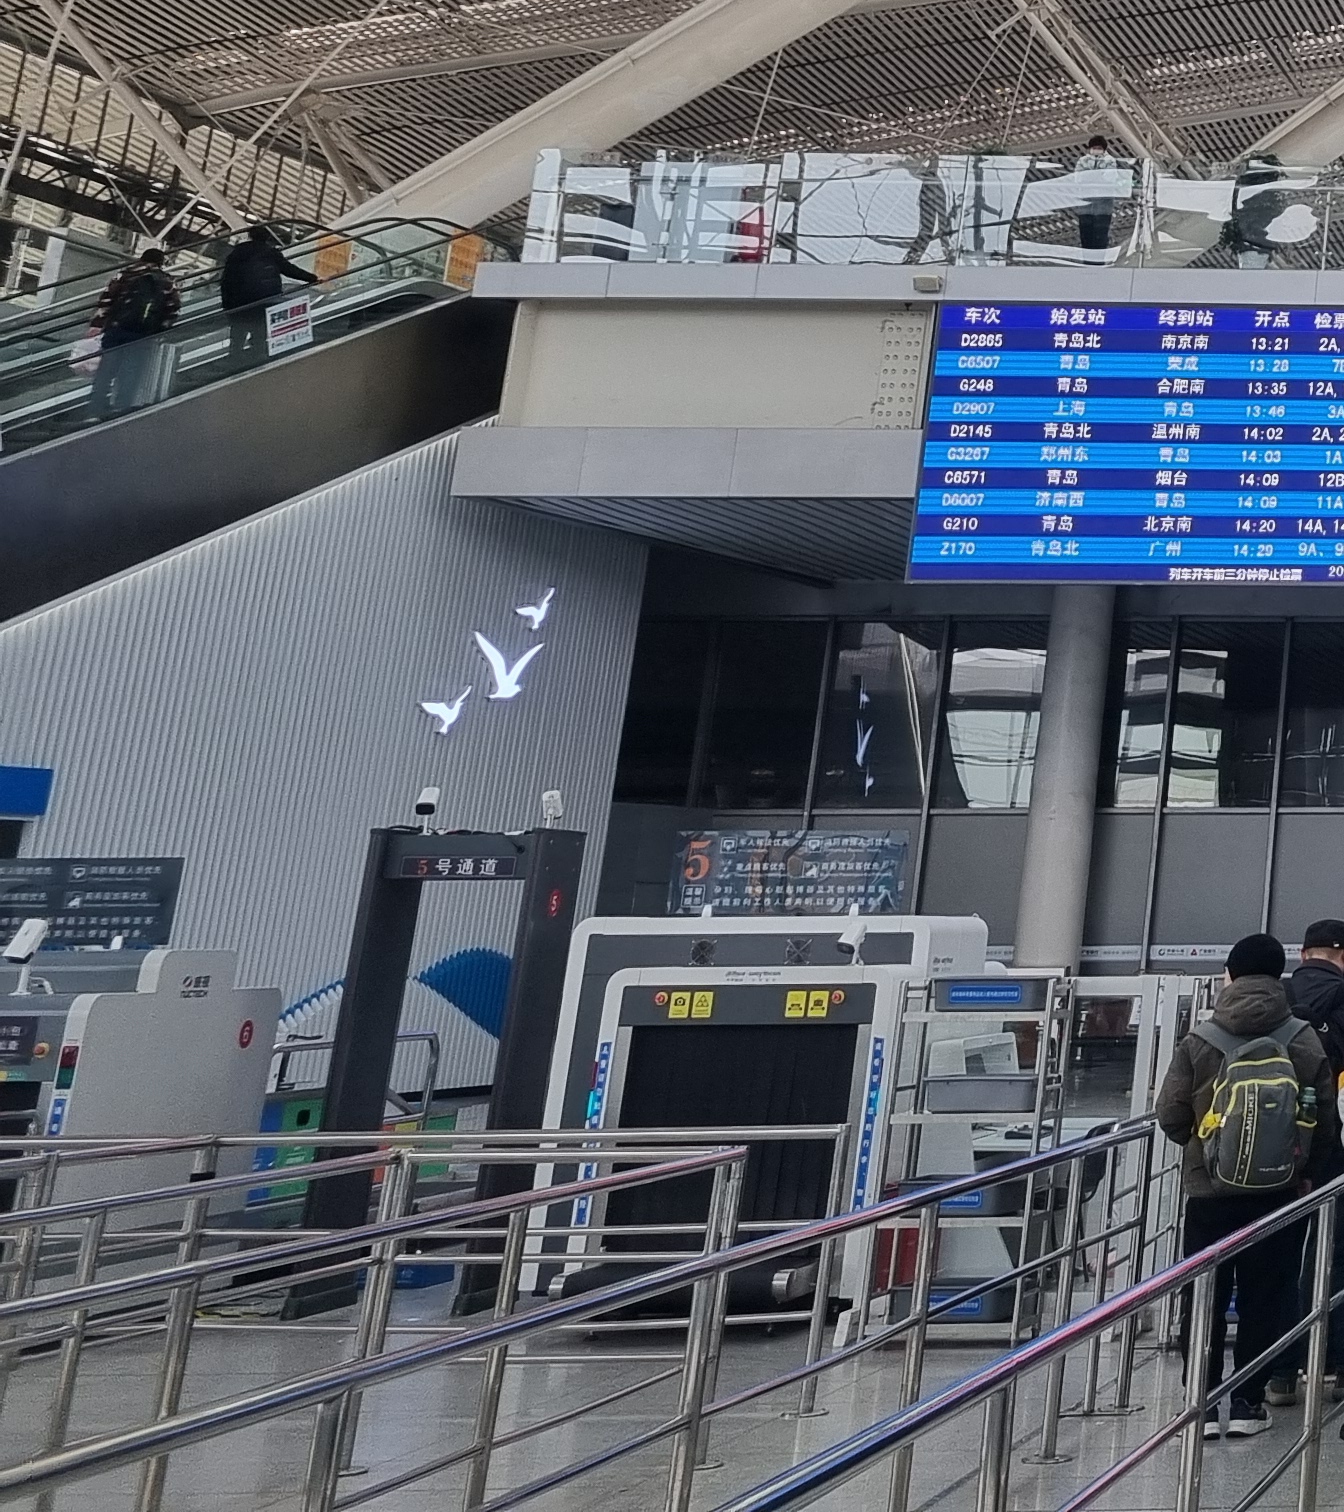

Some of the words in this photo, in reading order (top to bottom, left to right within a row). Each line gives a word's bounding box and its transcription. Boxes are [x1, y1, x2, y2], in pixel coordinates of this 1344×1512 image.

[964, 306, 1001, 325] 车次
[1049, 307, 1107, 326] 始发站
[1158, 309, 1215, 327] 终到站
[1254, 310, 1290, 328] 开点
[960, 333, 1003, 348] D2865
[1053, 331, 1102, 349] 青岛北
[1161, 333, 1210, 350] 南京南
[1251, 337, 1289, 351] 13:21
[959, 378, 994, 392] G248
[1056, 376, 1088, 394] 青岛
[1156, 377, 1206, 395] 合肥南
[1247, 381, 1287, 395] 13:35
[949, 424, 993, 438] D2145
[1043, 422, 1092, 439] 青岛北
[1151, 423, 1201, 440] 温州南
[1243, 427, 1284, 441] 14:02
[944, 470, 986, 485] C6571
[1046, 469, 1078, 486] 青岛
[1155, 469, 1188, 486] 烟台
[1239, 473, 1280, 487] 14:09
[942, 517, 979, 531] G210
[1041, 514, 1074, 532] 青岛
[1142, 515, 1193, 533] 北京南
[1235, 519, 1276, 533] 14:20
[685, 840, 712, 880] 5
